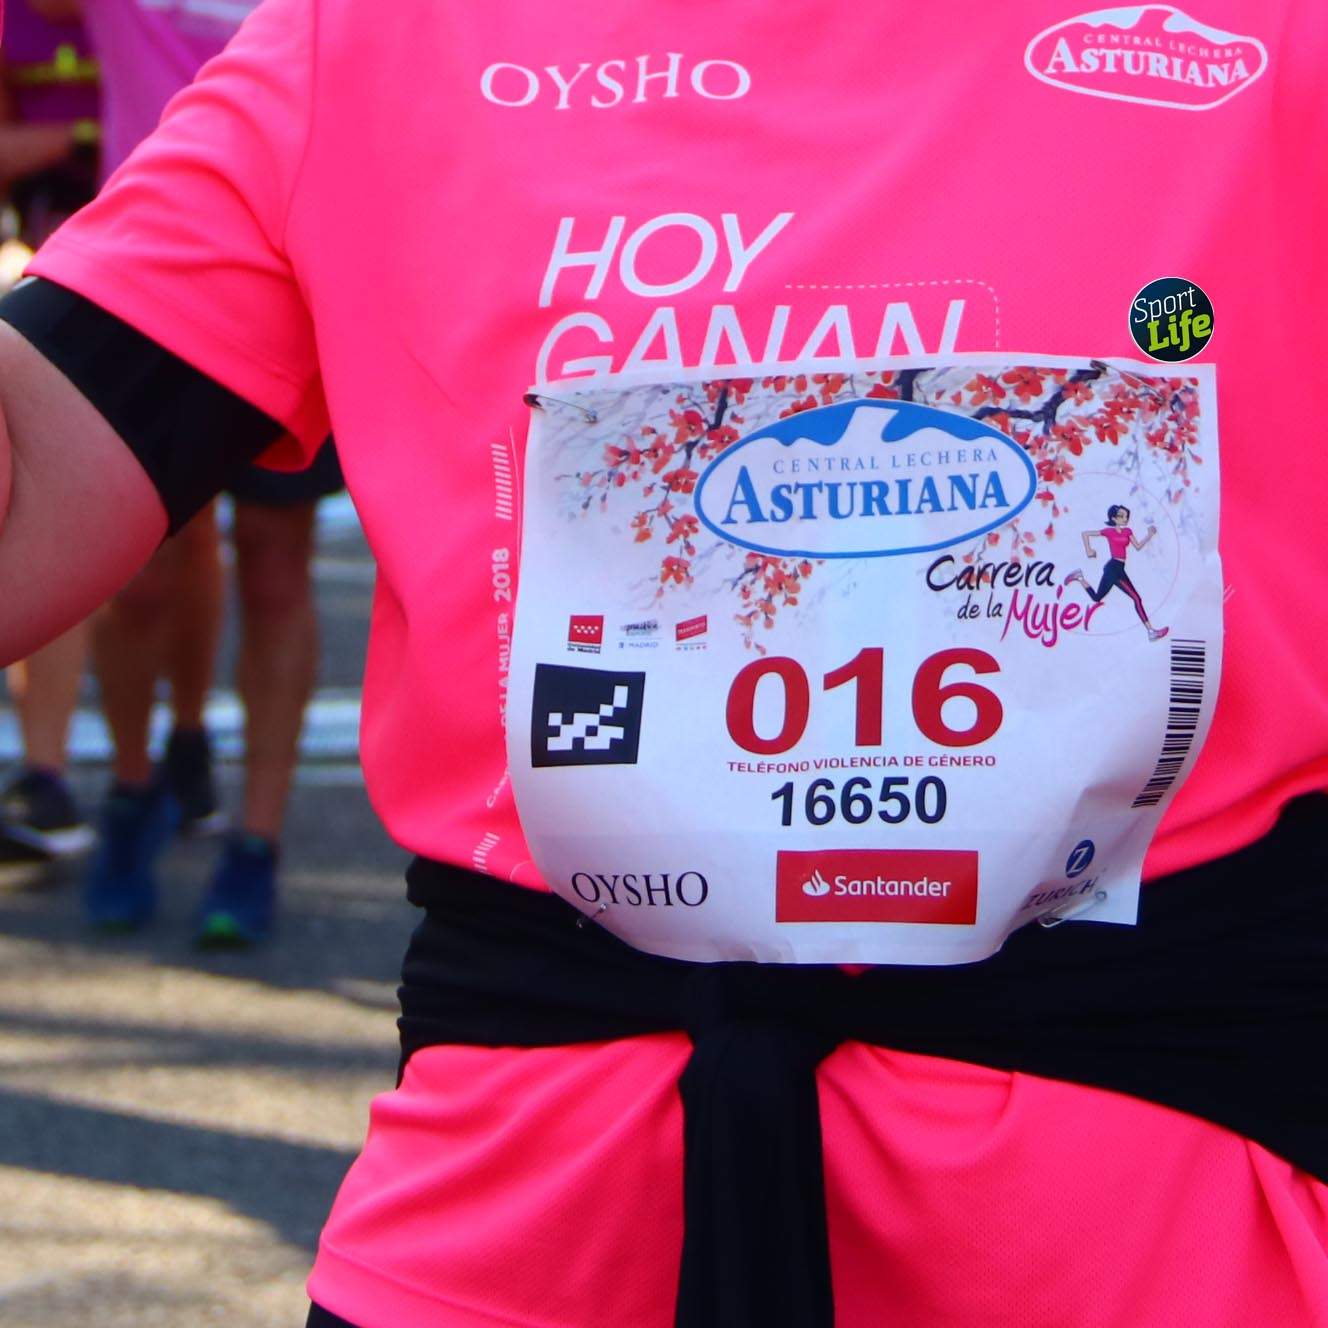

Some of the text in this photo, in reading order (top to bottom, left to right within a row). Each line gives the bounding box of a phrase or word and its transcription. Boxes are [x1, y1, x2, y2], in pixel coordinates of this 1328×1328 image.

[1044, 36, 1250, 89] ASTURIANA
[1083, 32, 1244, 60] CENTRAL LECHERA
[479, 51, 752, 110] OYSHO
[538, 211, 796, 309] HOY
[1133, 285, 1197, 324] Sport
[1146, 308, 1213, 353] Life
[535, 302, 964, 385] GANAN
[773, 447, 999, 475] CENTRAL LECHERA
[721, 464, 1011, 525] ASTURIANA
[490, 546, 513, 604] 2018
[925, 554, 1056, 592] Carrera
[496, 610, 512, 672] MUJER
[956, 584, 1105, 649] de la Mujer
[725, 646, 1004, 756] 016
[727, 753, 997, 774] TELÉFONO VIOLENCIA DE GÉNERO
[770, 775, 948, 827] 16650
[571, 871, 709, 907] OYSHO
[834, 874, 952, 898] Santander
